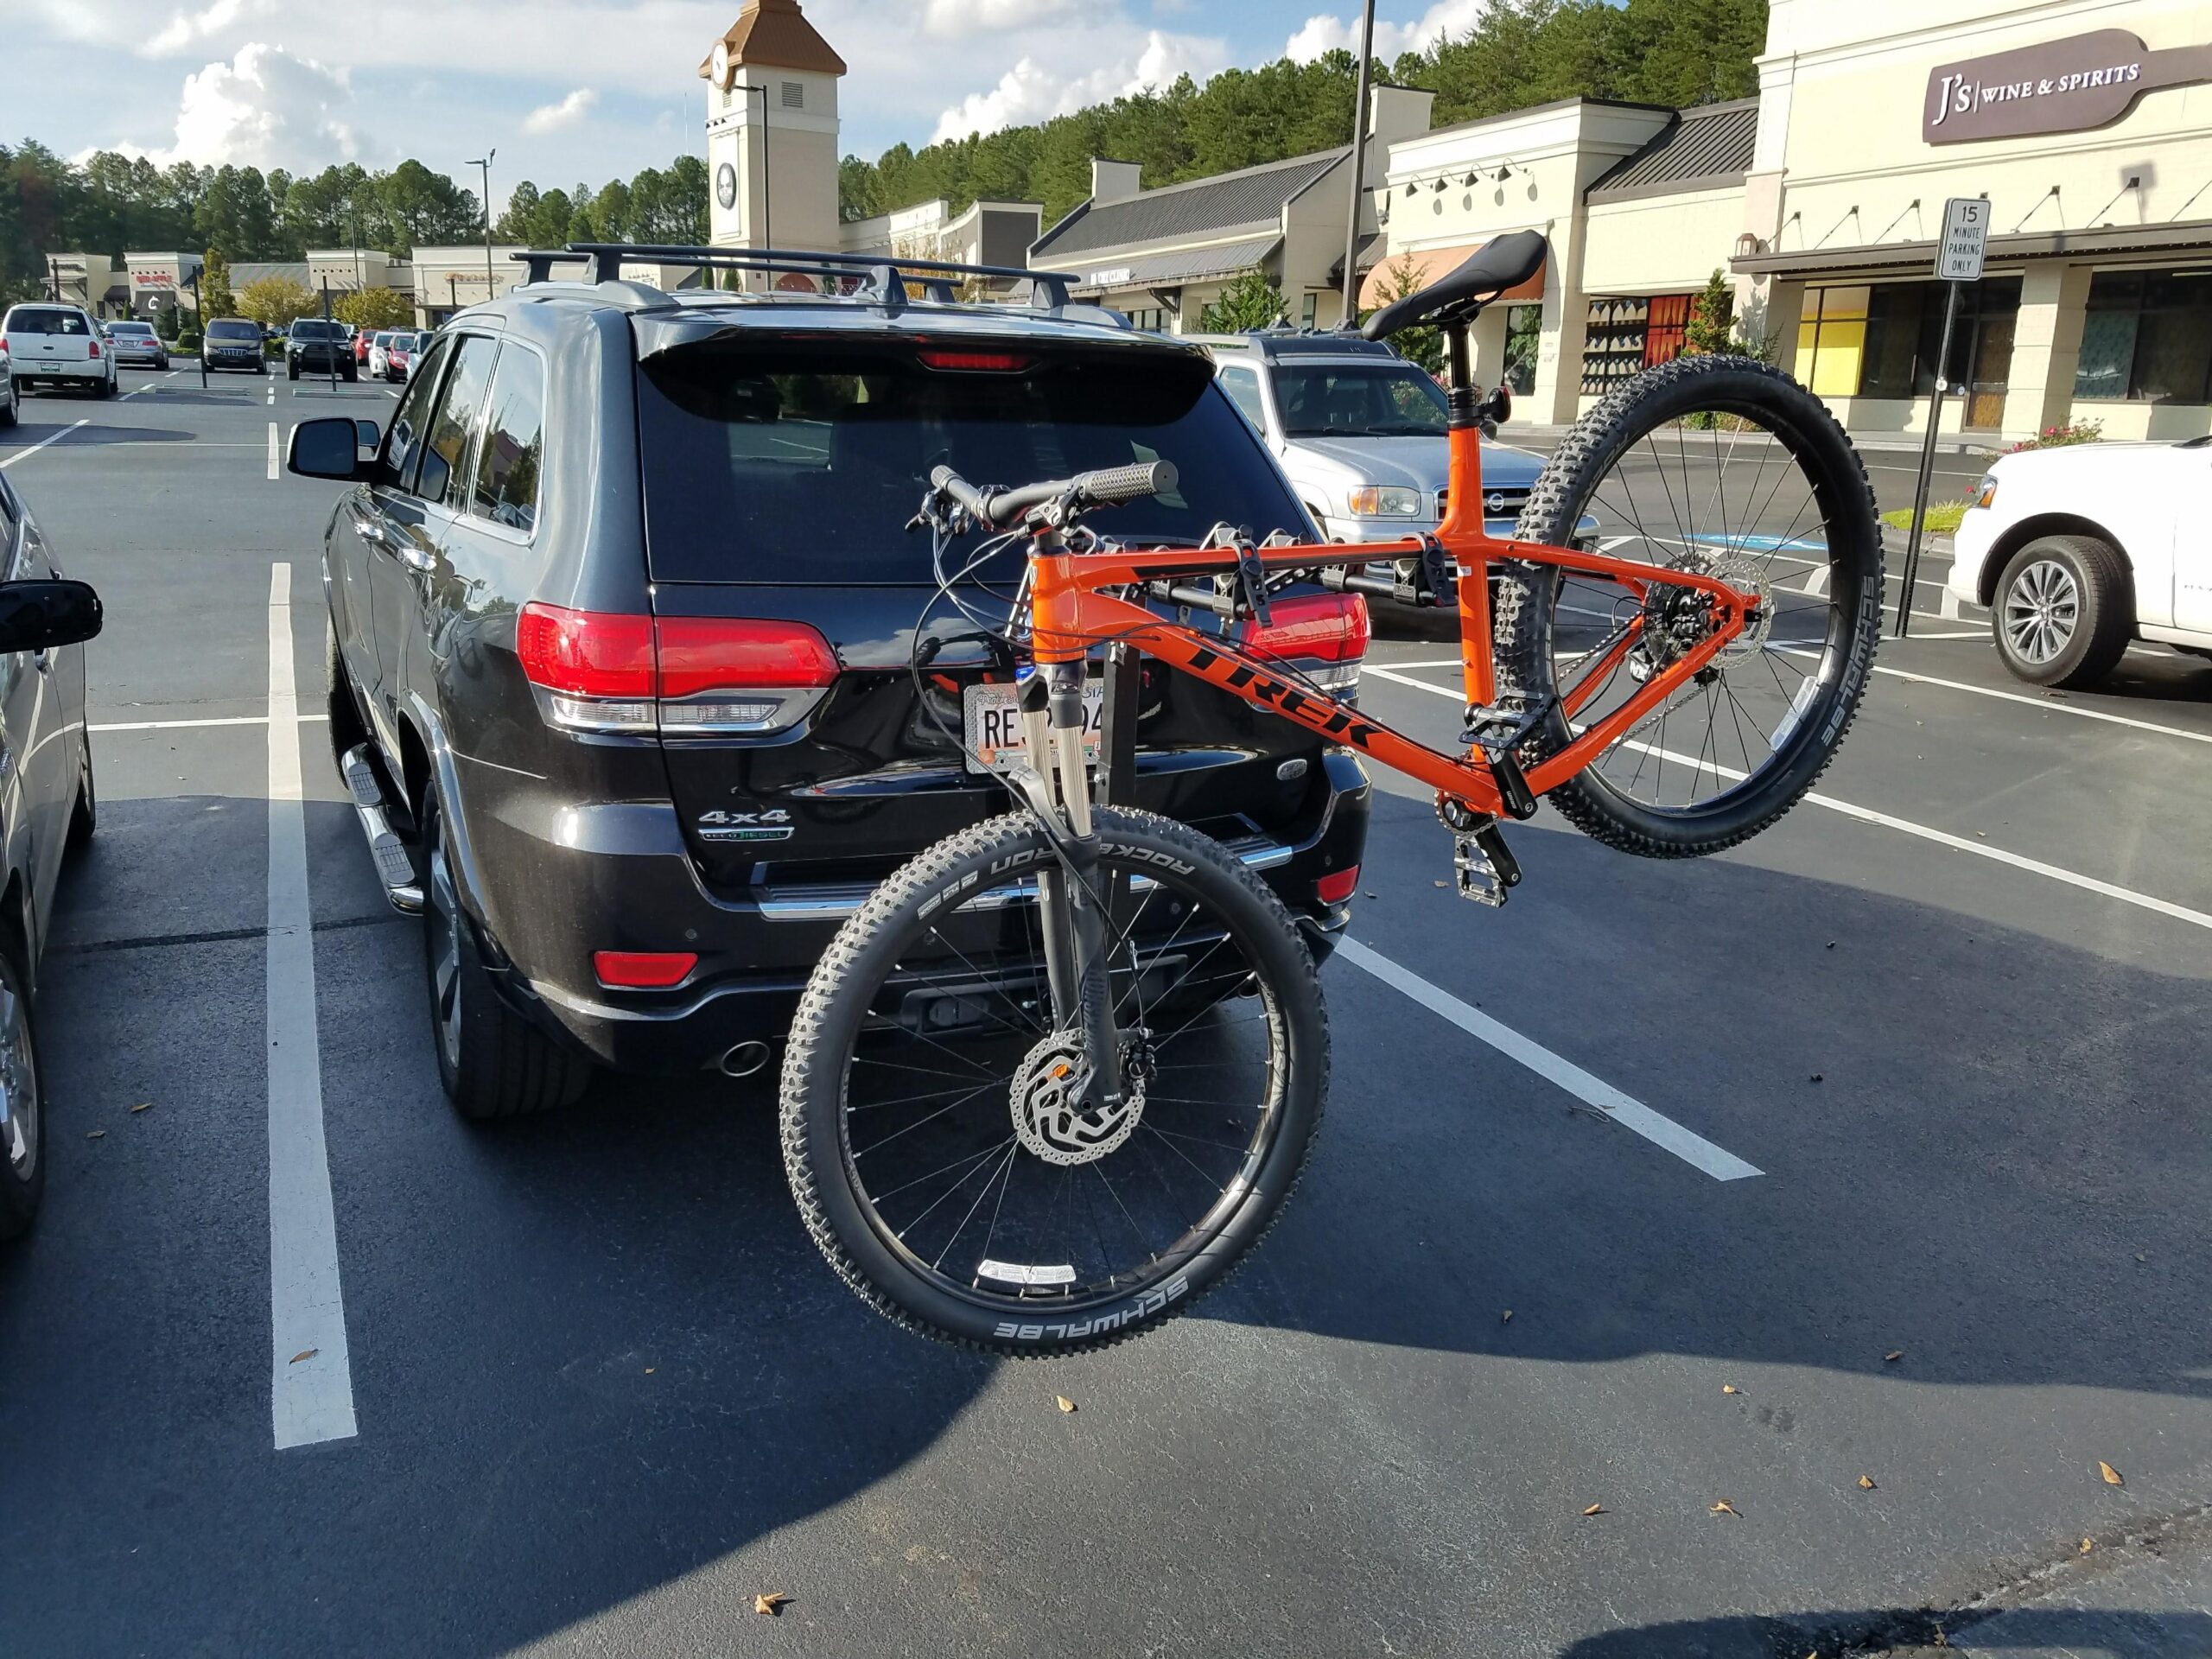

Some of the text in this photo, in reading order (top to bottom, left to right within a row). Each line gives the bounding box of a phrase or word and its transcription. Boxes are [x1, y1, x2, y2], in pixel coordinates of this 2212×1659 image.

[1932, 62, 2141, 125] J's WINE & SPIRITS
[1962, 206, 1978, 223] 15
[1954, 226, 1981, 238] MINUTE
[1948, 243, 1980, 256] PARKING
[1952, 259, 1972, 272] ONLY
[1821, 575, 1875, 747] SCHWALBE
[1187, 647, 1382, 749] TREK
[698, 810, 791, 823] 4x4
[1099, 842, 1196, 876] ROCKE
[994, 1275, 1190, 1340] SCHWALBE
